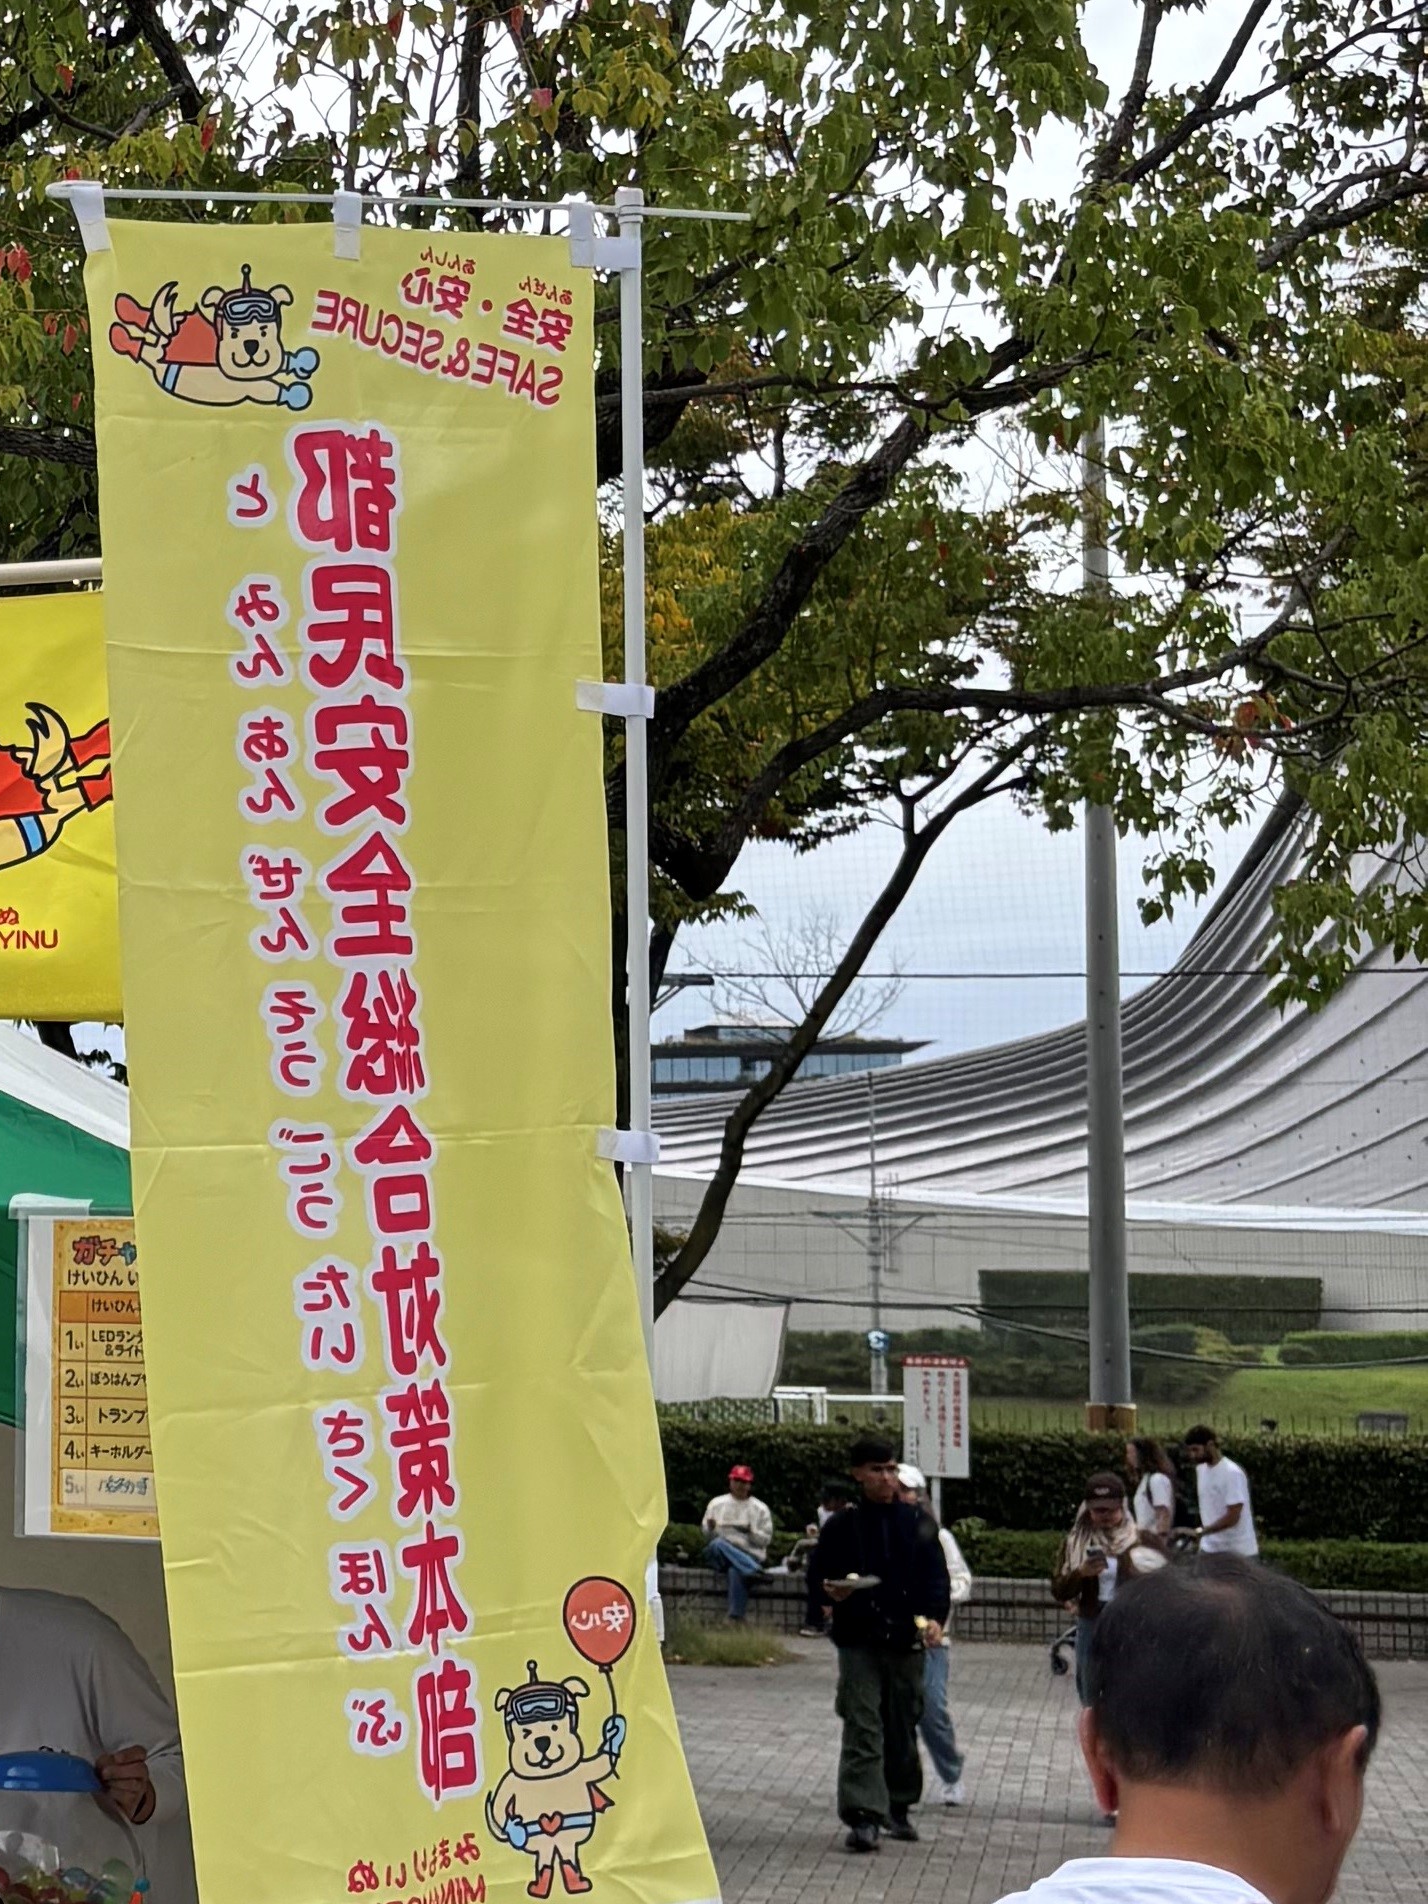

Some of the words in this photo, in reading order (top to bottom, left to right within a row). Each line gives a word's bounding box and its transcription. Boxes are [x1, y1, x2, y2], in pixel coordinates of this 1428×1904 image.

[68, 1270, 123, 1286] けいひん
[92, 1299, 141, 1313] けいひん
